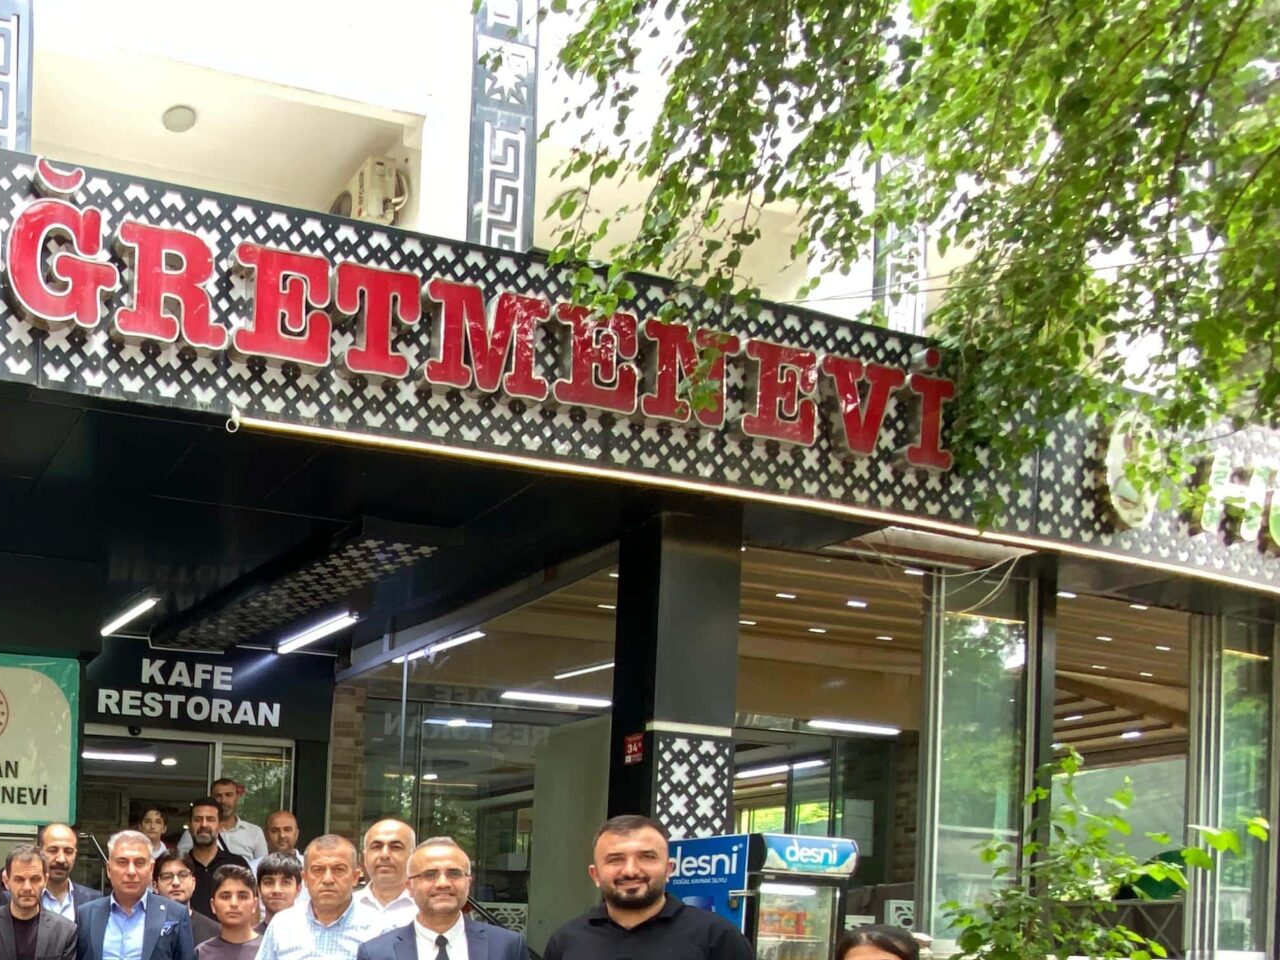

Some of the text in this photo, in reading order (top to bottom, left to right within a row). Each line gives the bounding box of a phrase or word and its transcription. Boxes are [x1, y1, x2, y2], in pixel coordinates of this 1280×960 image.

[141, 658, 234, 691] KAFE
[97, 688, 281, 728] RESTORAN
[668, 845, 739, 877] desni
[785, 839, 839, 865] desni
